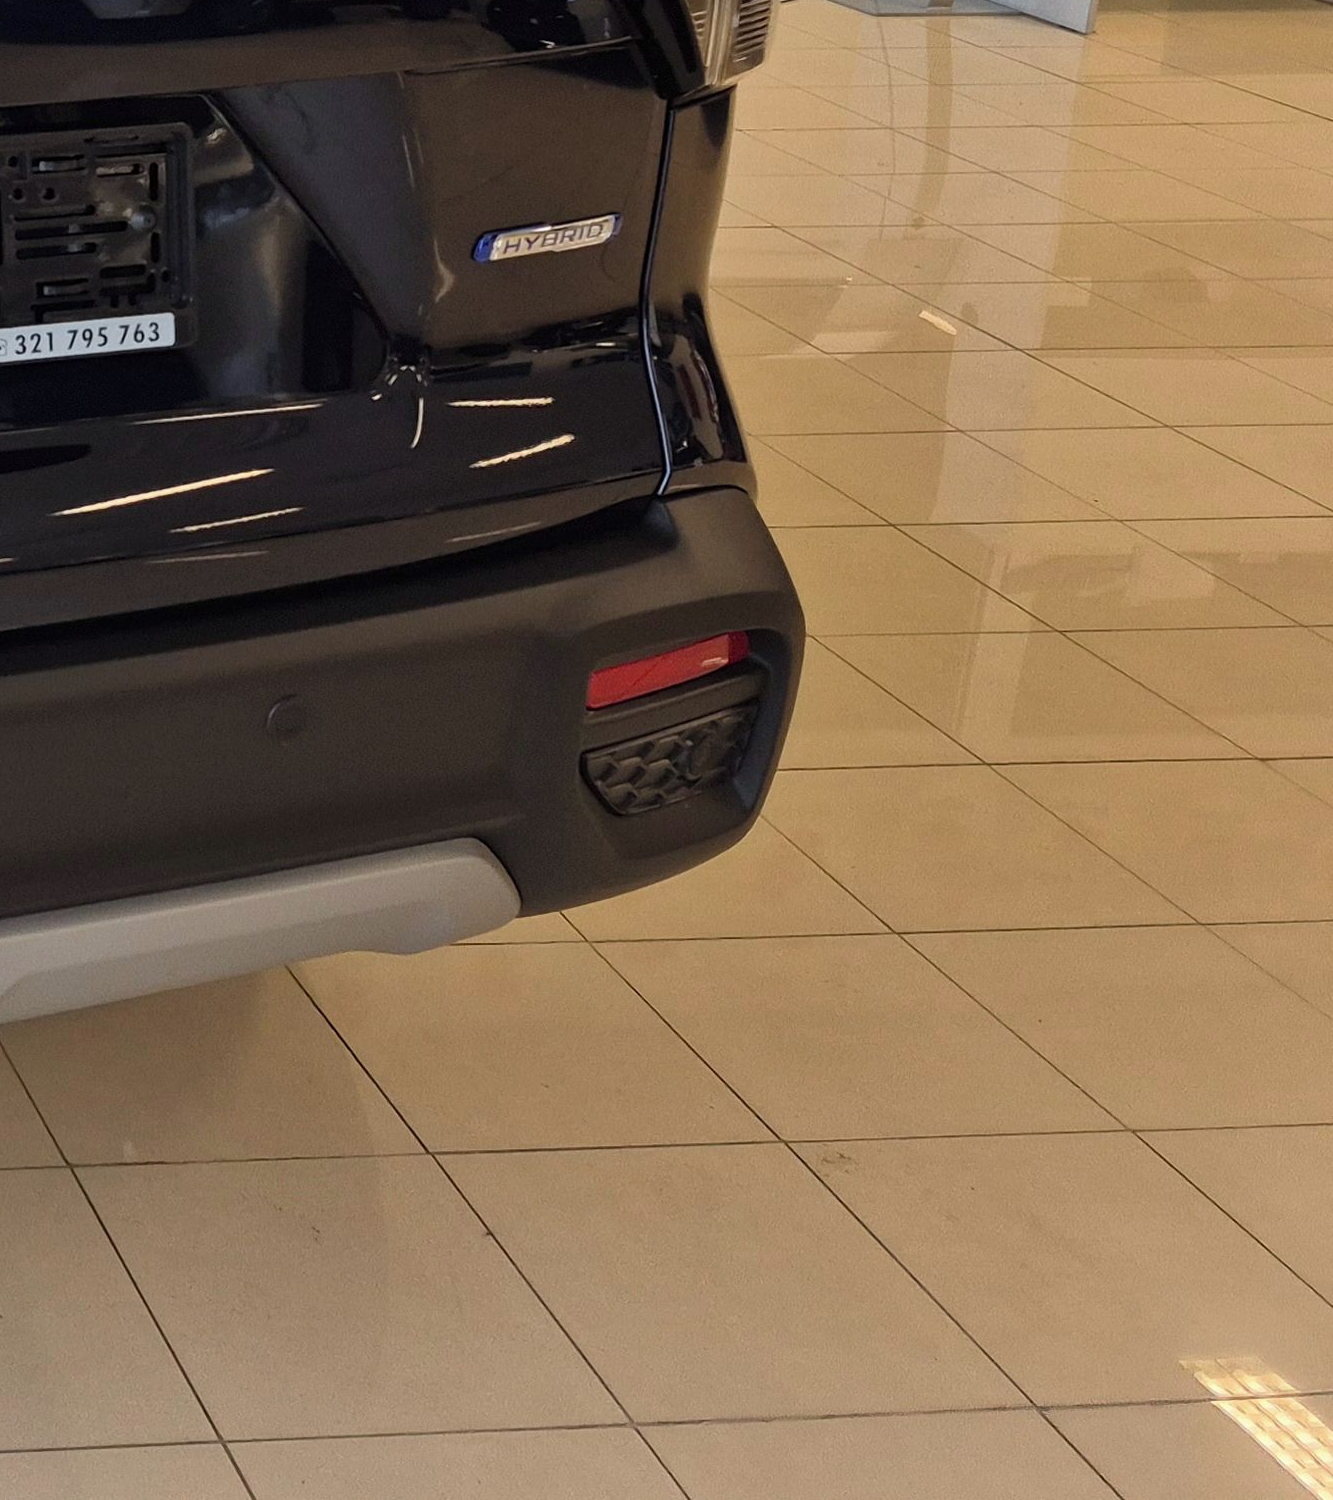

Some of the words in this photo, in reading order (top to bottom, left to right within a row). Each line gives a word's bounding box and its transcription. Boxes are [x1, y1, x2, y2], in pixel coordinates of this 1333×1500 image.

[502, 221, 605, 255] HYBRID
[14, 332, 55, 356] 321
[67, 325, 109, 350] 795
[118, 321, 162, 345] 763
